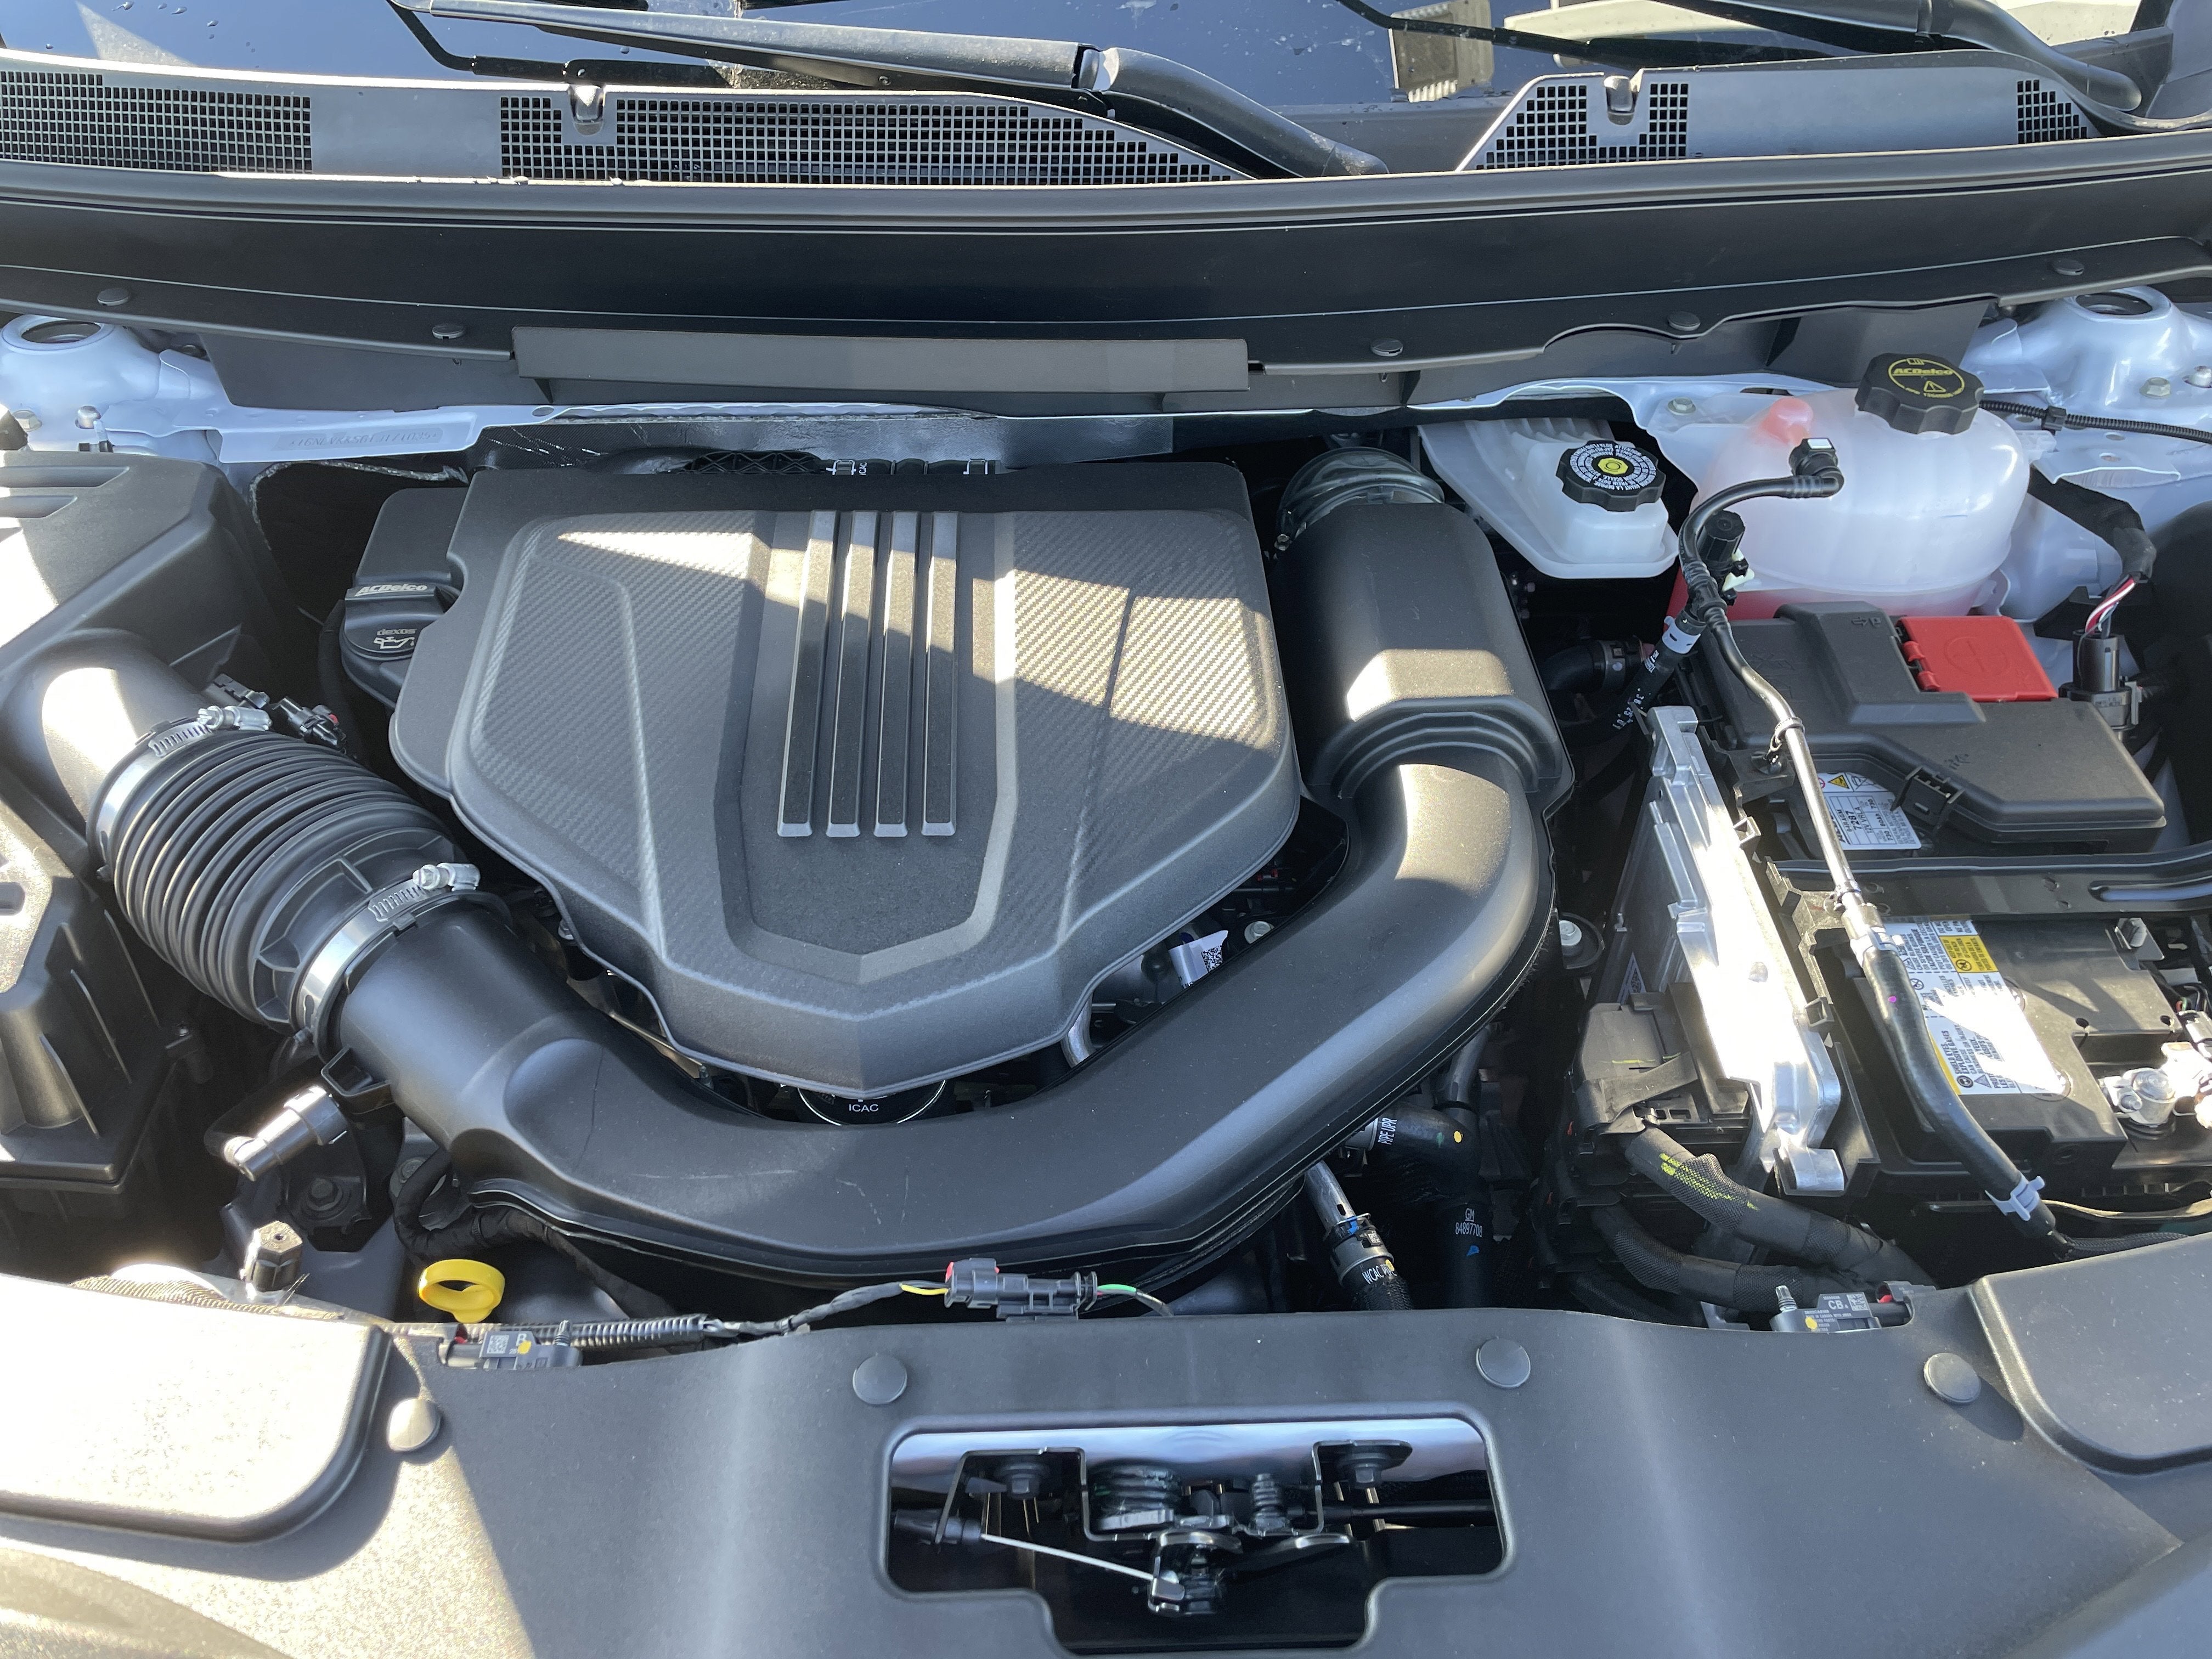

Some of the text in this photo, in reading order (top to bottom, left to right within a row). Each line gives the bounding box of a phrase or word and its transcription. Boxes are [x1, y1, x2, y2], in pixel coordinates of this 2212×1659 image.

[859, 462, 867, 475] ICAC
[355, 584, 428, 596] ACDelco
[1867, 799, 1877, 809] 730
[1845, 810, 1862, 830] 7287
[1854, 806, 1873, 833] 12V VRLA
[1883, 831, 1893, 840] 730
[1940, 1030, 1970, 1074] EXPLOSIVE GASES
[1946, 1057, 1963, 1074] SHIELD
[1958, 1049, 1978, 1074] CAN CAUSE
[848, 1104, 879, 1112] ICAC
[1378, 1118, 1397, 1145] PIPE UPR
[1465, 1208, 1475, 1221] GM
[1455, 1222, 1482, 1237] 84897708
[1362, 1265, 1384, 1284] WCAC
[1828, 1300, 1844, 1310] CB
